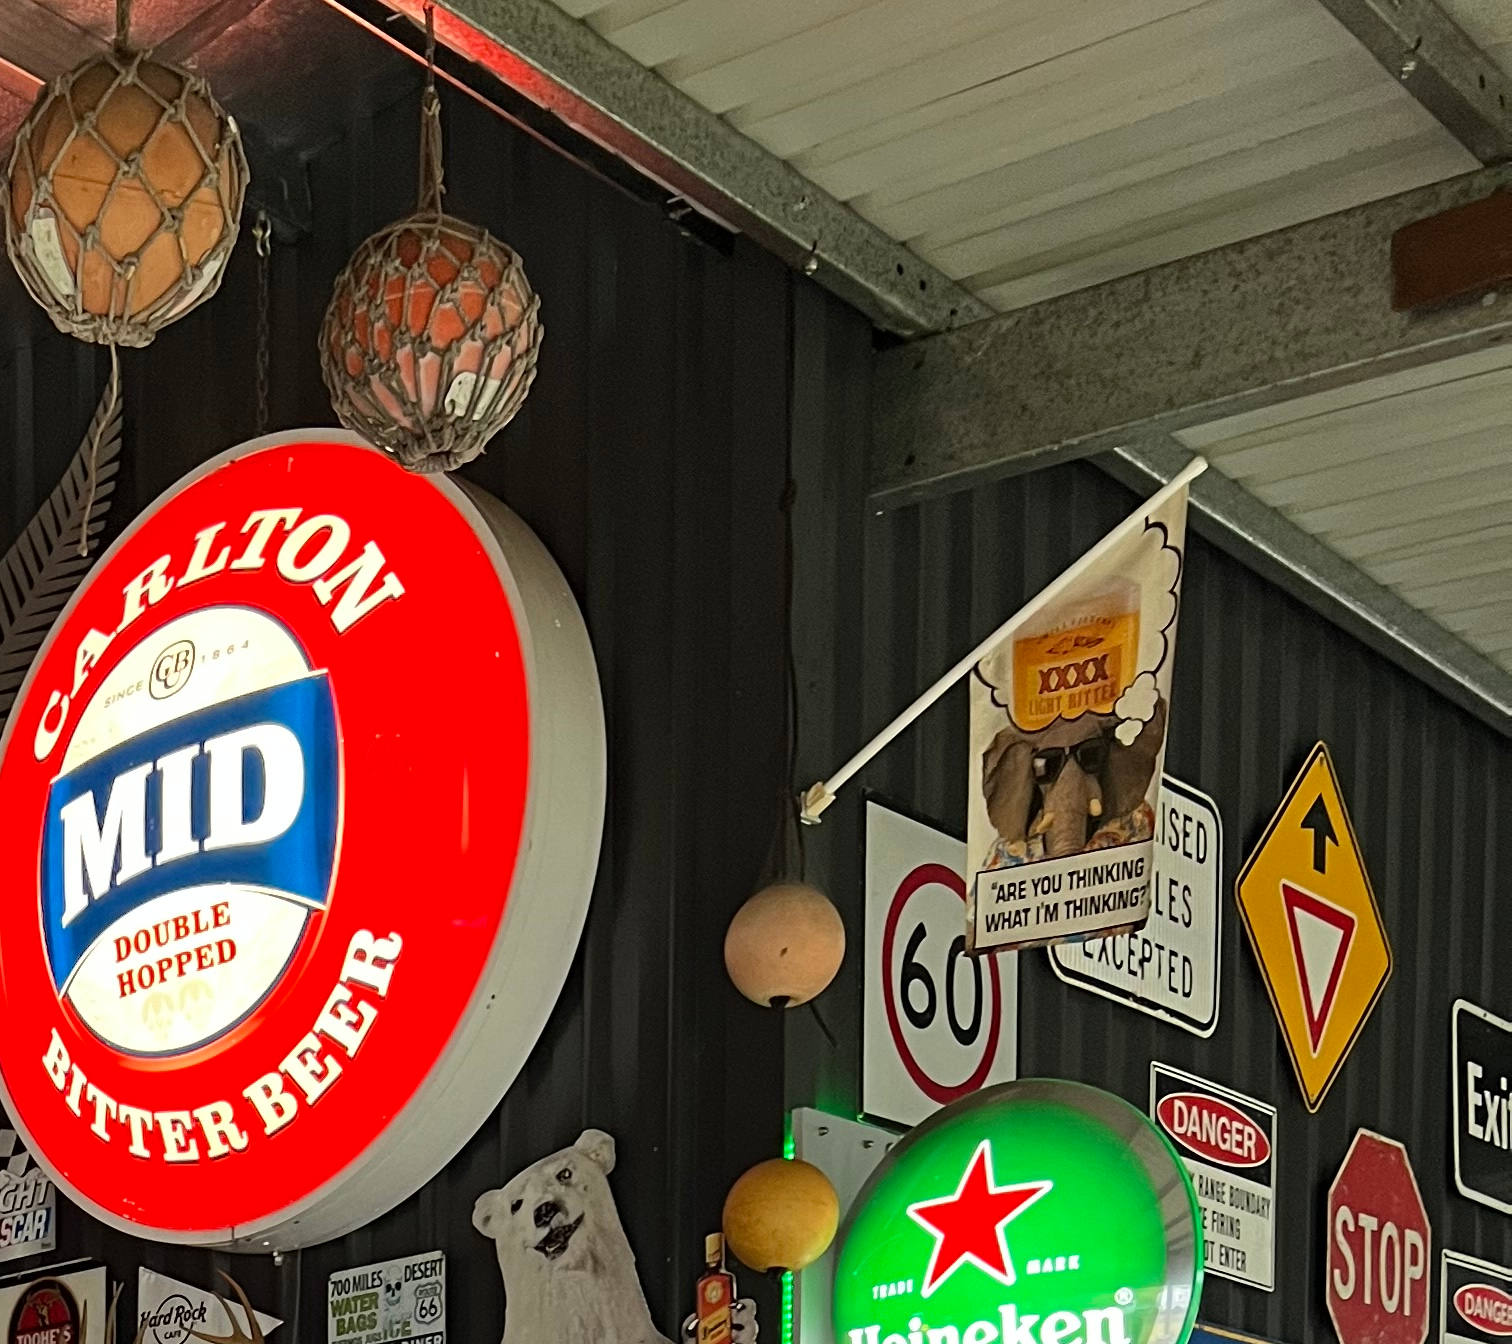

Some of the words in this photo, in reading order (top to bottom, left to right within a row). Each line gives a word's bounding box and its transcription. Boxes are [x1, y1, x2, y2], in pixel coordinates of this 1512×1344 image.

[33, 506, 407, 761] CARLTON
[102, 679, 144, 710] SINCE
[200, 638, 250, 664] 1864
[1039, 654, 1109, 694] XXXX
[59, 721, 305, 926] MID
[1155, 802, 1208, 865] ISED
[1031, 875, 1063, 898] YOU
[1066, 857, 1145, 890] THINKING
[1154, 870, 1194, 929] LES
[114, 900, 232, 965] DOUBLE
[985, 907, 1032, 933] WHAT
[1035, 901, 1059, 927] I'M
[116, 937, 238, 1000] HOPPED
[899, 921, 984, 1048] 60
[40, 1027, 250, 1164] BITTER
[242, 928, 405, 1138] BEER
[1173, 1098, 1257, 1161] DANGER
[330, 1277, 351, 1298] 700
[352, 1270, 383, 1293] MILES
[404, 1259, 444, 1283] DESERT
[872, 1279, 915, 1300] TRADE
[1025, 1255, 1081, 1275] MARK
[1333, 1204, 1426, 1318] STOP
[140, 1308, 173, 1329] Hard
[175, 1301, 207, 1324] Rock
[330, 1292, 379, 1318] WATER
[336, 1312, 377, 1337] BAGS
[419, 1297, 438, 1318] 66
[1464, 1292, 1512, 1327] DANGE
